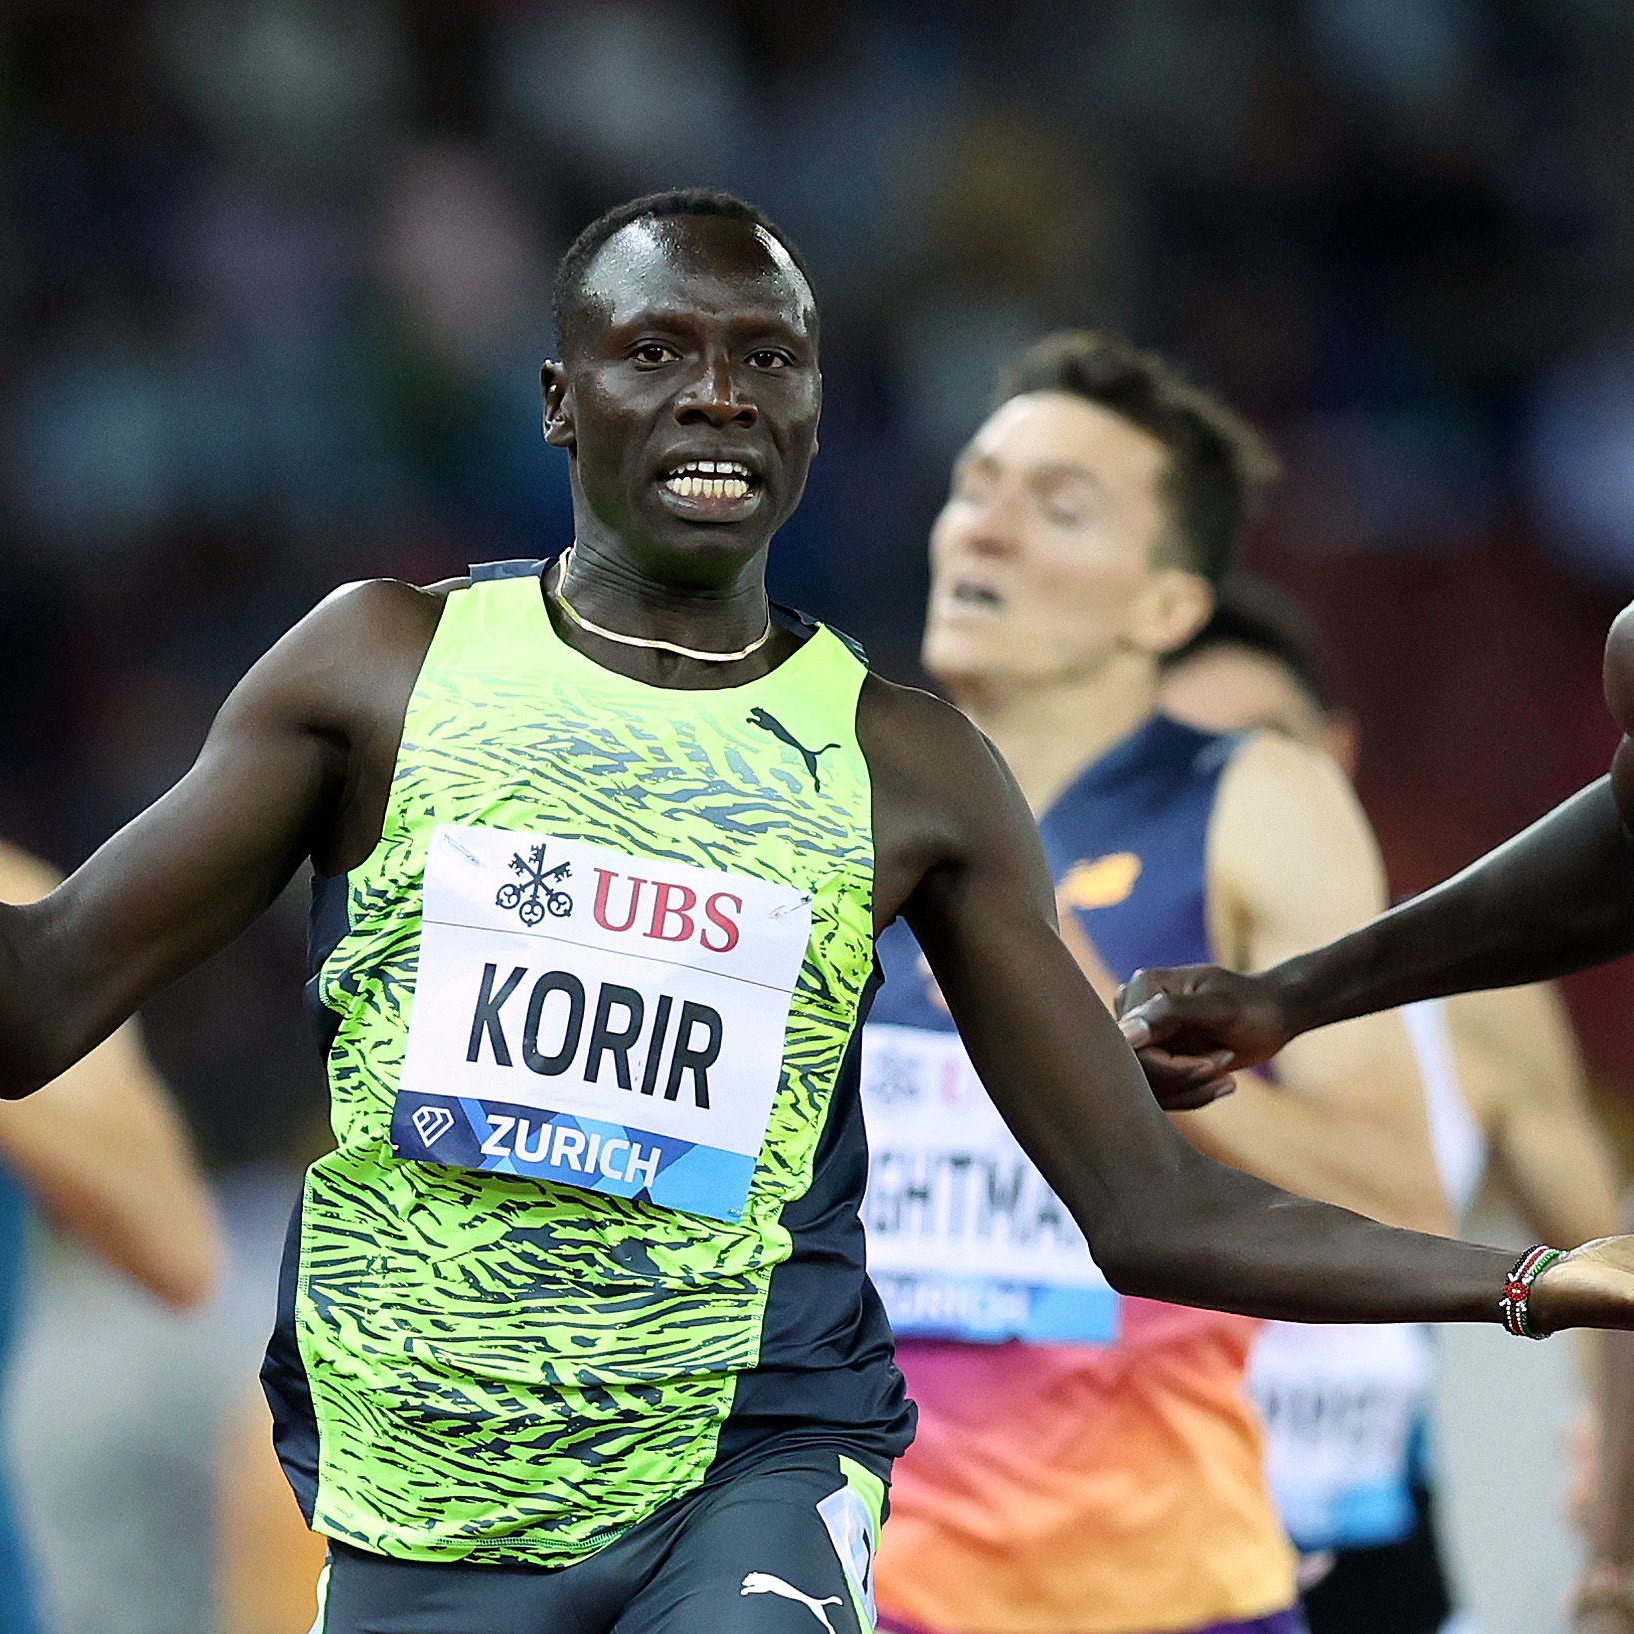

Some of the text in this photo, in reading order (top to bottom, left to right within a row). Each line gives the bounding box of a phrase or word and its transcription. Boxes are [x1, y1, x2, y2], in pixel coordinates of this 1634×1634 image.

[593, 868, 744, 953] UBS
[466, 962, 723, 1110] KORIR
[480, 1113, 663, 1188] ZURICH
